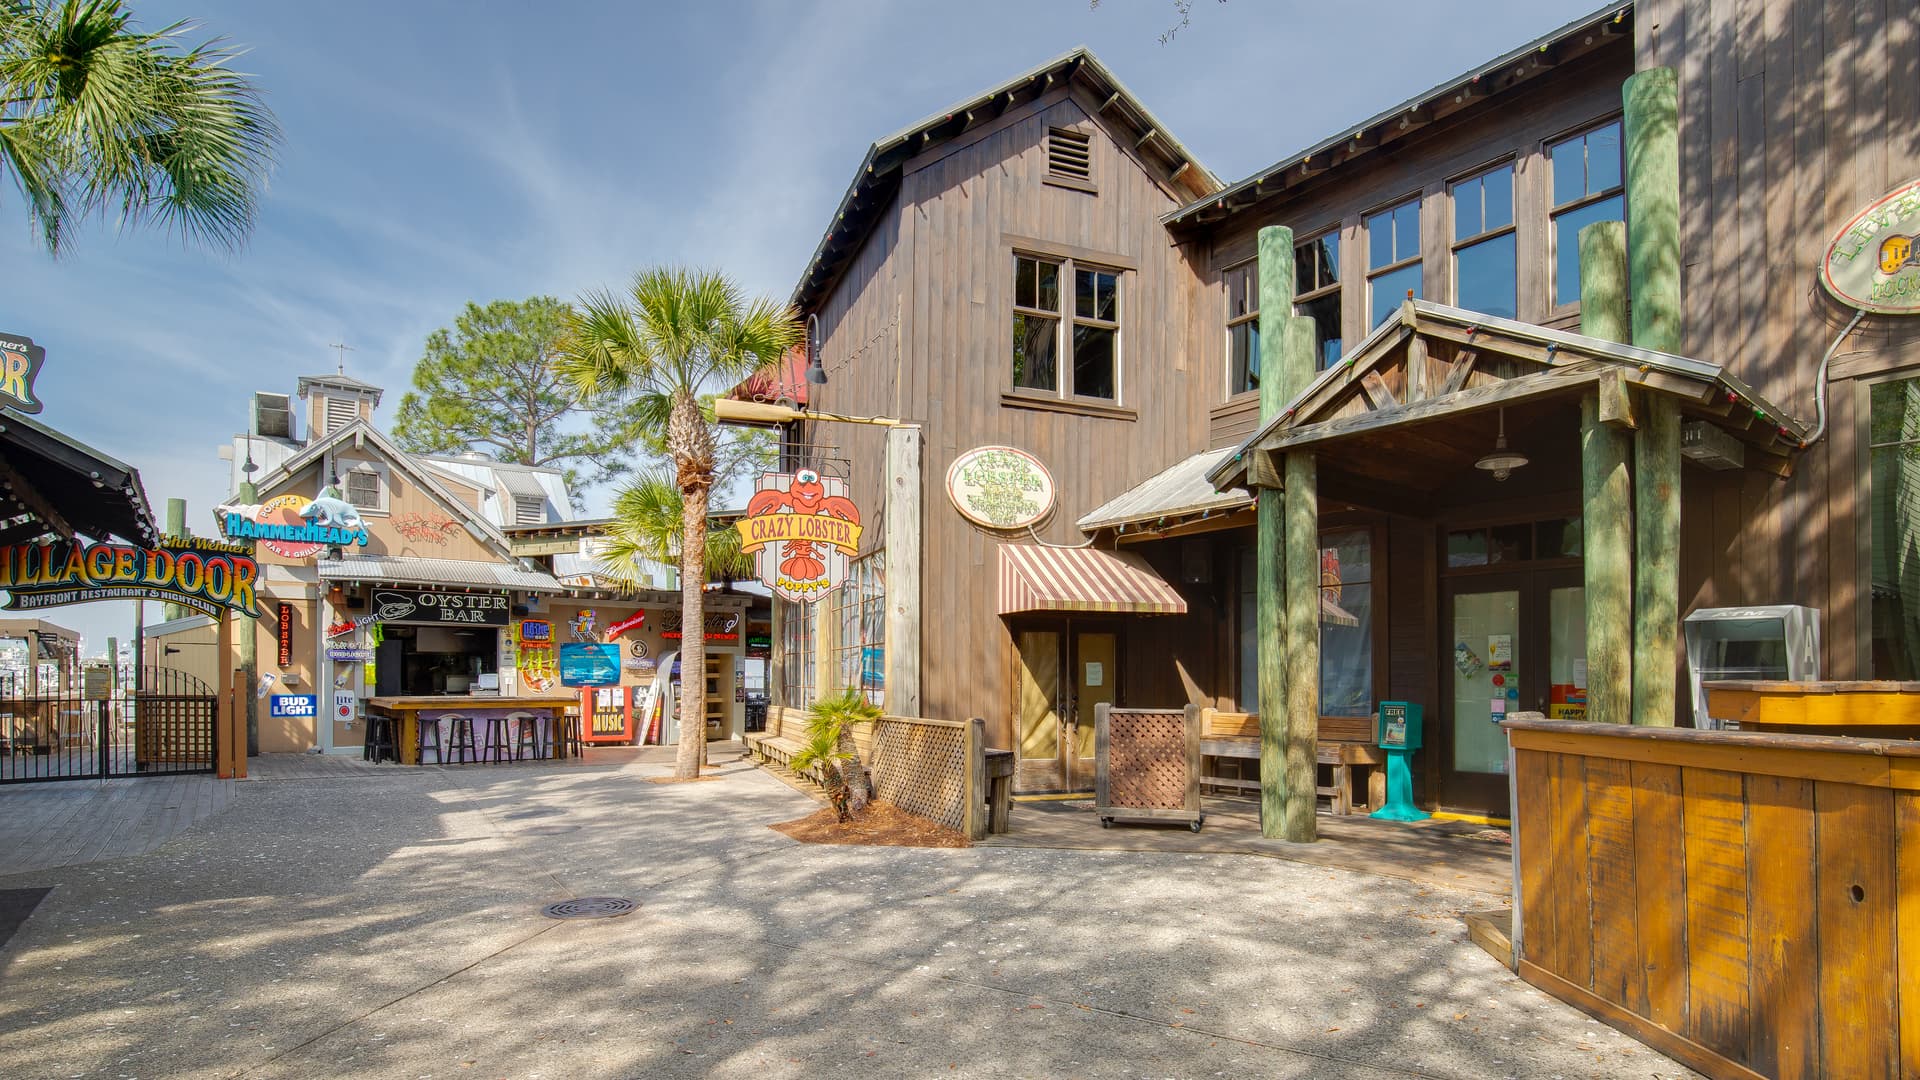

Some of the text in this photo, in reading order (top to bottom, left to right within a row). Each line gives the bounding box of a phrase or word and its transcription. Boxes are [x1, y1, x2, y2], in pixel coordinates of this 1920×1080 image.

[260, 495, 297, 518] POPPY'S
[751, 517, 851, 544] CRAZY LOBSTER
[264, 541, 281, 555] BAR
[140, 547, 261, 618] DOOR
[776, 577, 831, 593] POPPY'S
[20, 587, 217, 615] BAYFRONT RESTAURANT & NIGHTCLUB
[418, 593, 508, 610] OYSTER
[354, 613, 380, 627] LIGHT
[440, 608, 486, 622] BAR
[1712, 610, 1768, 618] ATM
[280, 605, 291, 665] LOBSTER
[279, 696, 308, 706] BUD
[273, 706, 314, 715] LIGHT
[1385, 708, 1405, 716] FREE
[592, 714, 625, 732] MUSIC
